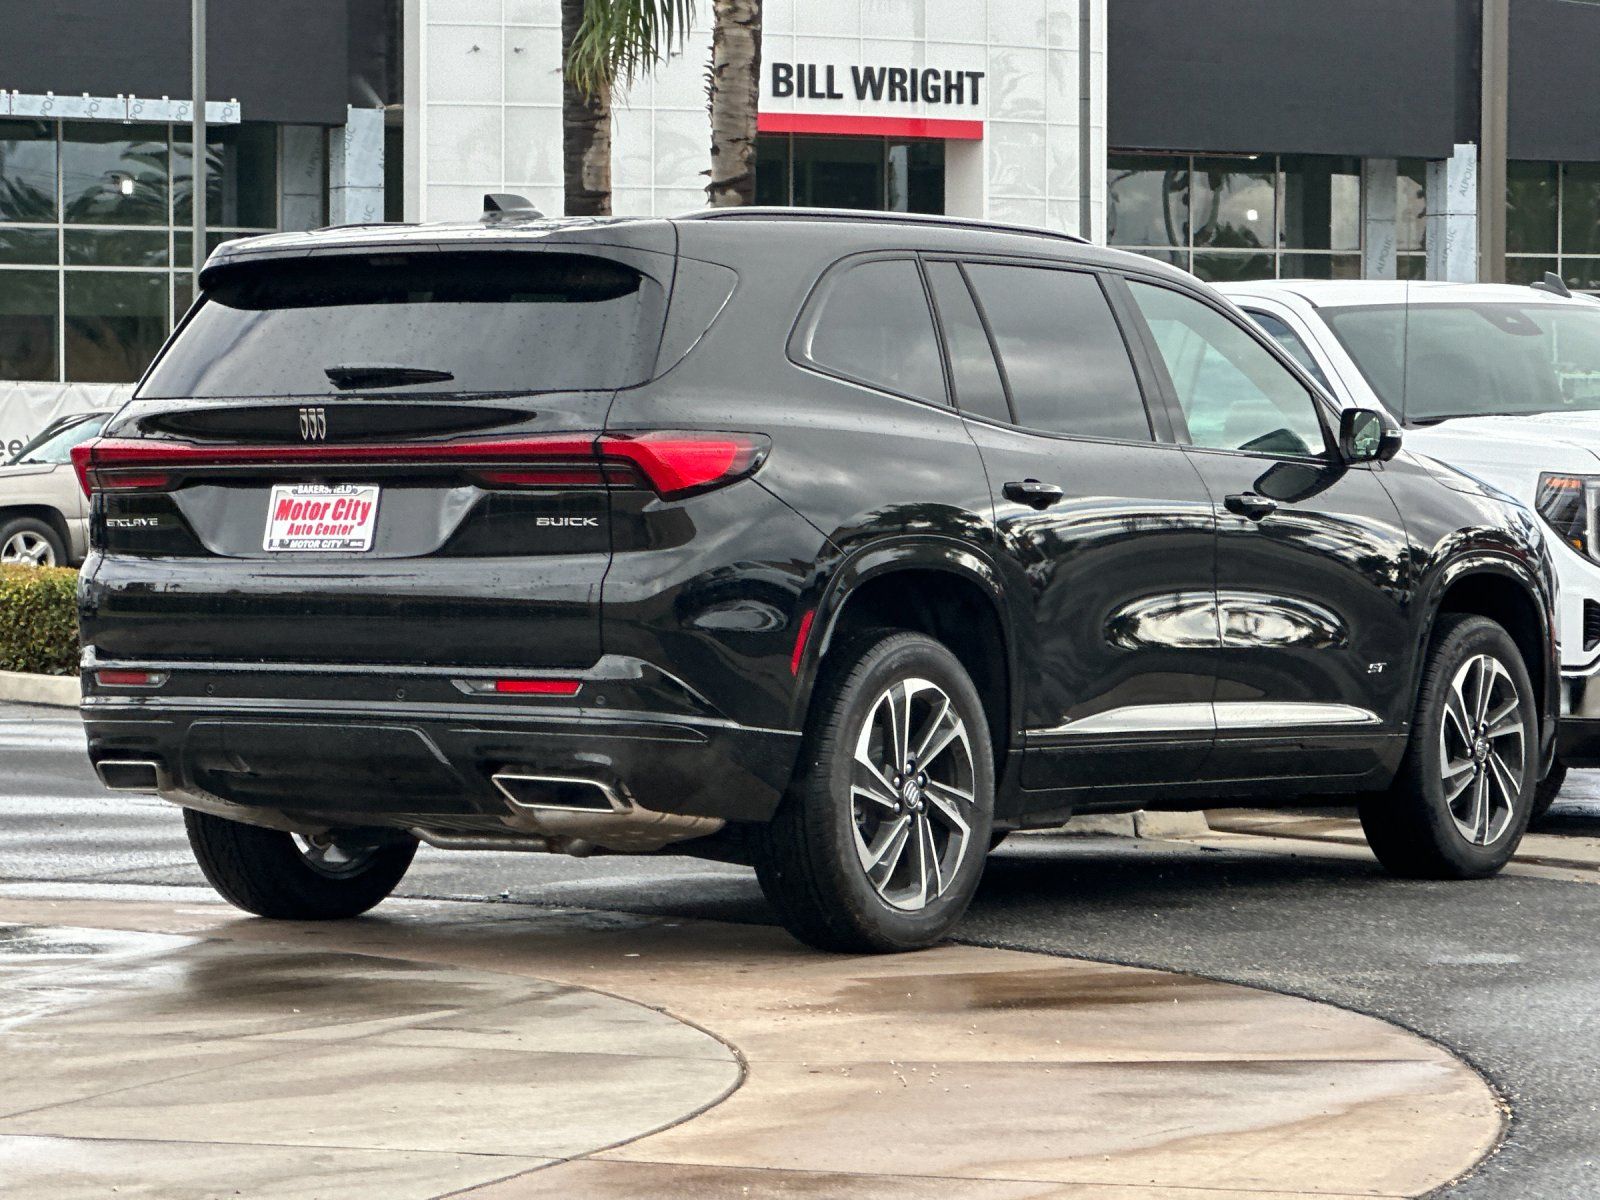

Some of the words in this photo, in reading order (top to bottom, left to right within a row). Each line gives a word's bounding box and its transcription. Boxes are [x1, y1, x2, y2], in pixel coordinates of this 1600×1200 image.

[772, 62, 843, 99] BILL
[851, 66, 985, 105] WRIGHT
[275, 499, 331, 521] Motor
[331, 498, 372, 526] City
[536, 517, 599, 526] BUICK
[287, 523, 313, 535] Auto
[314, 523, 355, 535] Center
[289, 539, 321, 549] MOTOR
[321, 539, 343, 549] CITY
